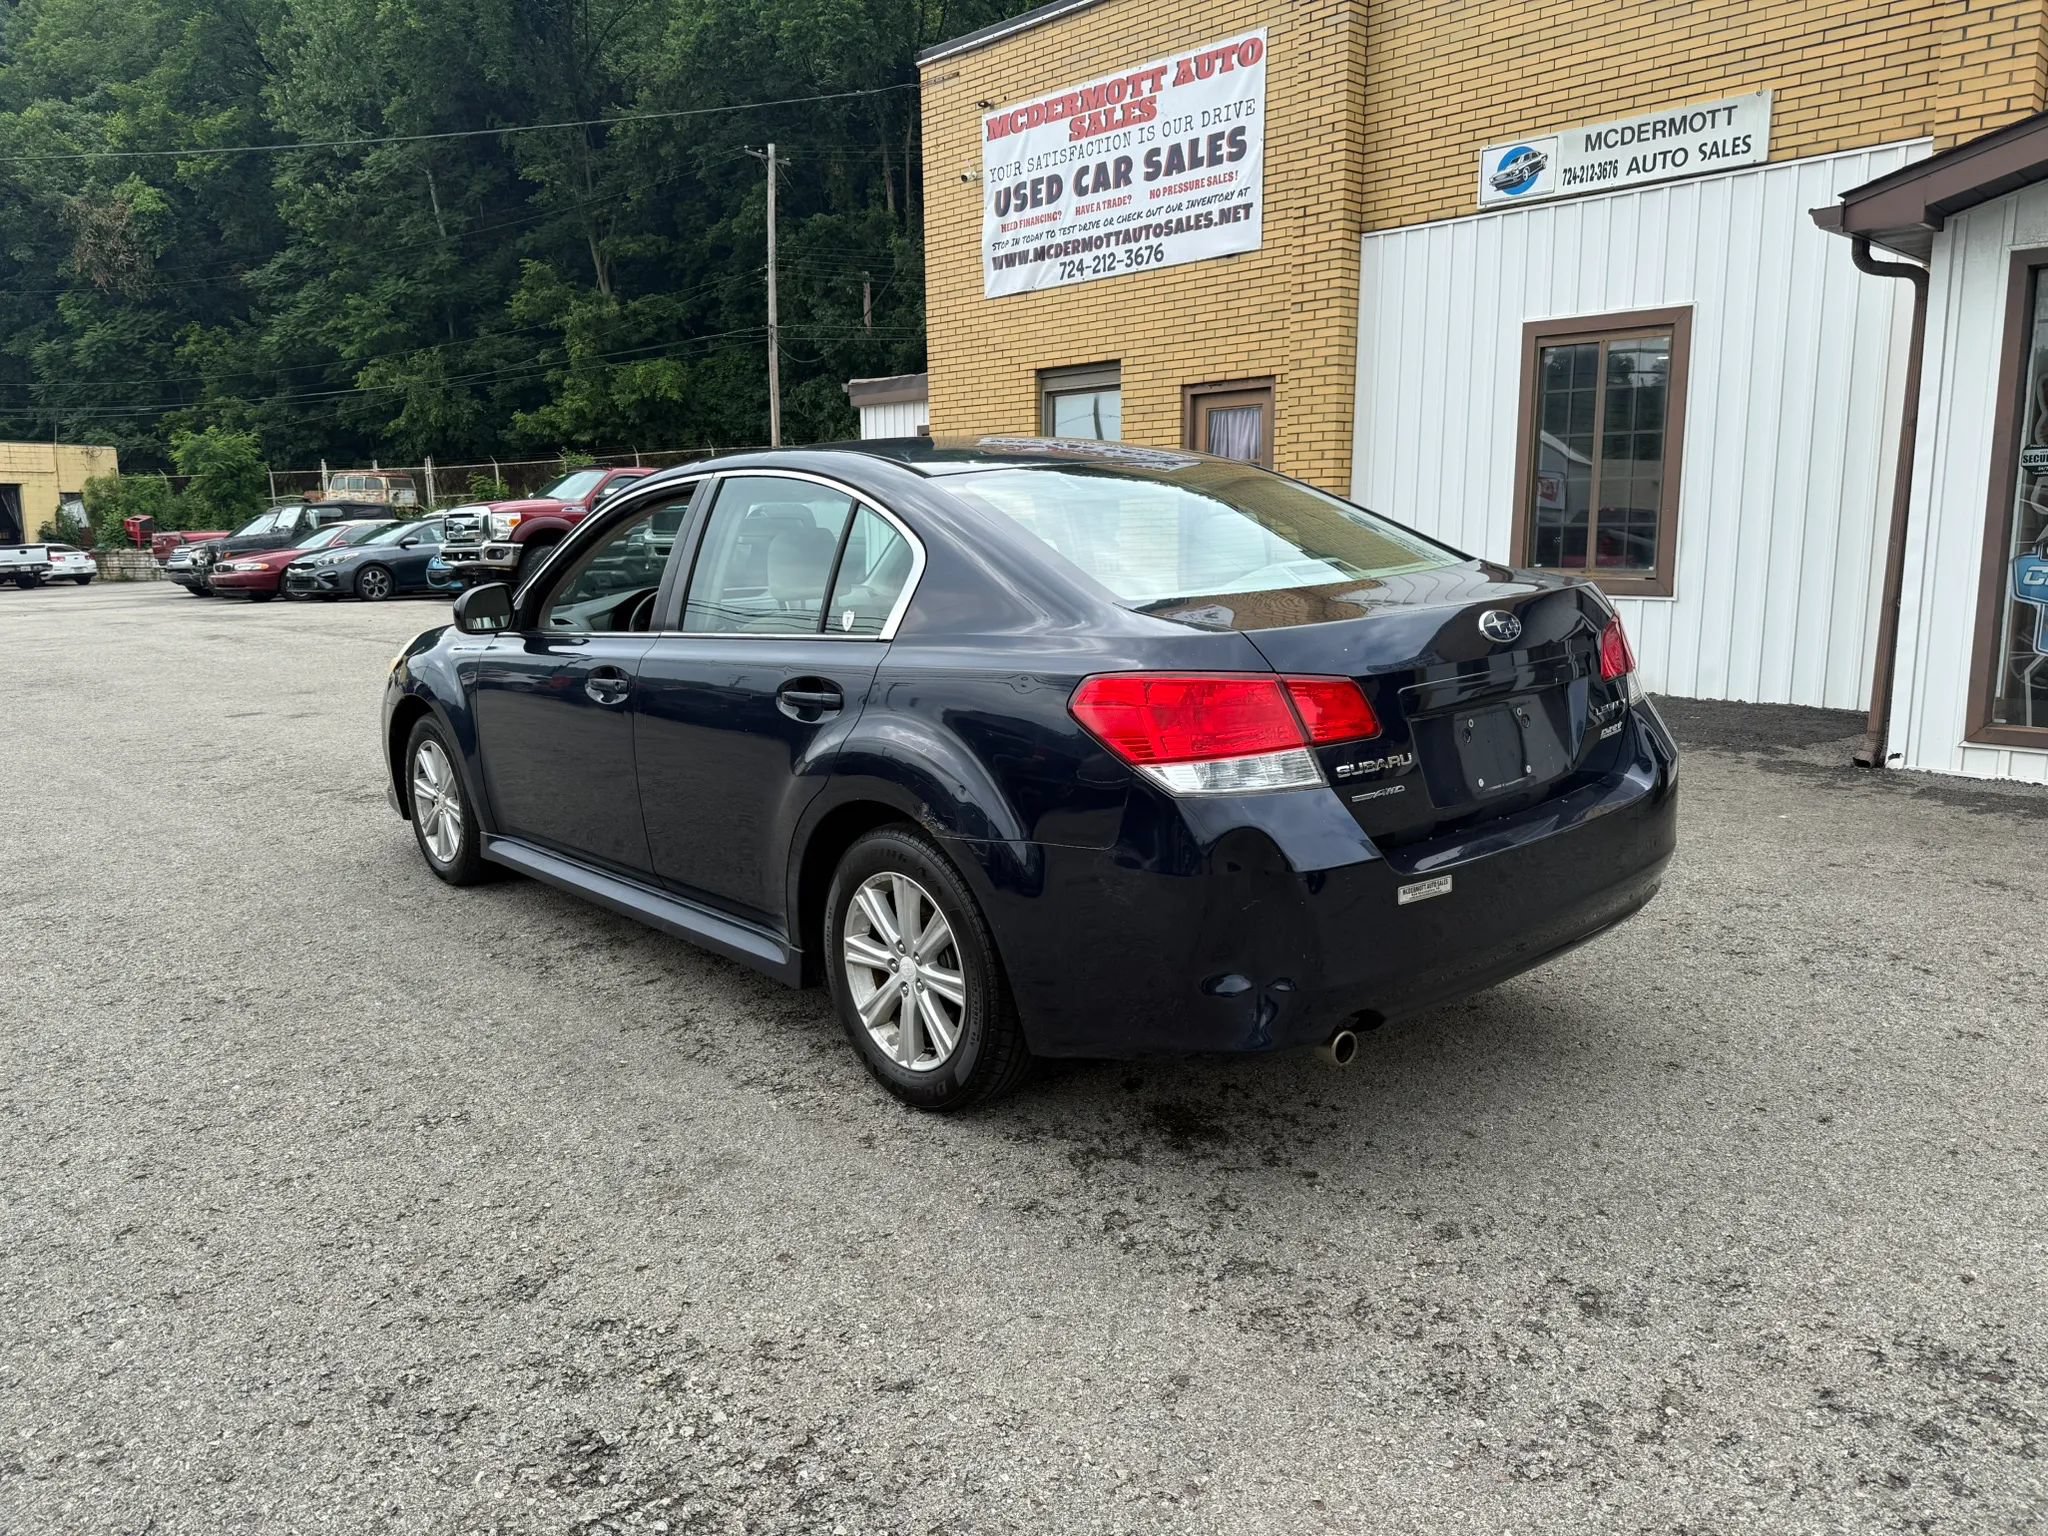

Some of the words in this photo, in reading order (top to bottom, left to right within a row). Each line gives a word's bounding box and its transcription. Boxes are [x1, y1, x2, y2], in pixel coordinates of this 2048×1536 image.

[986, 65, 1168, 142] MCDERMOTT
[1172, 37, 1264, 87] AUTO
[989, 160, 1023, 184] YOUR
[1027, 130, 1132, 173] SATISFACTION
[1138, 124, 1156, 145] IS
[1162, 114, 1195, 138] OUR
[1201, 98, 1256, 128] DRIVE
[1069, 95, 1158, 142] SALES
[1584, 105, 1738, 153] MCDERMOTT
[994, 173, 1064, 218] USED
[1072, 154, 1134, 198] CAR
[1143, 125, 1248, 182] SALES
[1562, 159, 1619, 186] 724-212-3676
[1625, 147, 1689, 177] AUTO
[1699, 134, 1752, 163] SALES
[1075, 202, 1095, 216] HAVE
[1095, 201, 1101, 213] A
[1102, 194, 1133, 210] TRADE?
[1149, 188, 1162, 200] NO
[1162, 177, 1206, 197] PRESSURE
[1206, 170, 1239, 188] SALES!
[992, 240, 1010, 252] STOP
[1011, 238, 1021, 247] IN
[1022, 231, 1045, 246] TODAY
[1045, 229, 1057, 239] TO
[1058, 225, 1079, 237] TEST
[1078, 219, 1102, 233] DRIVE
[1103, 216, 1115, 226] OR
[1116, 211, 1143, 224] CHECK
[1145, 206, 1164, 218] OUT
[1165, 202, 1184, 214] OUR
[1185, 190, 1237, 210] INVENTORY
[1236, 186, 1251, 198] AT
[992, 203, 1253, 271] WWW.MCDERMOTTAUTOSALES.NET
[1001, 221, 1019, 234] NEED
[1019, 210, 1063, 230] FINANCING?
[1059, 242, 1164, 280] 724-212-3676
[1336, 753, 1412, 778] SUBARU
